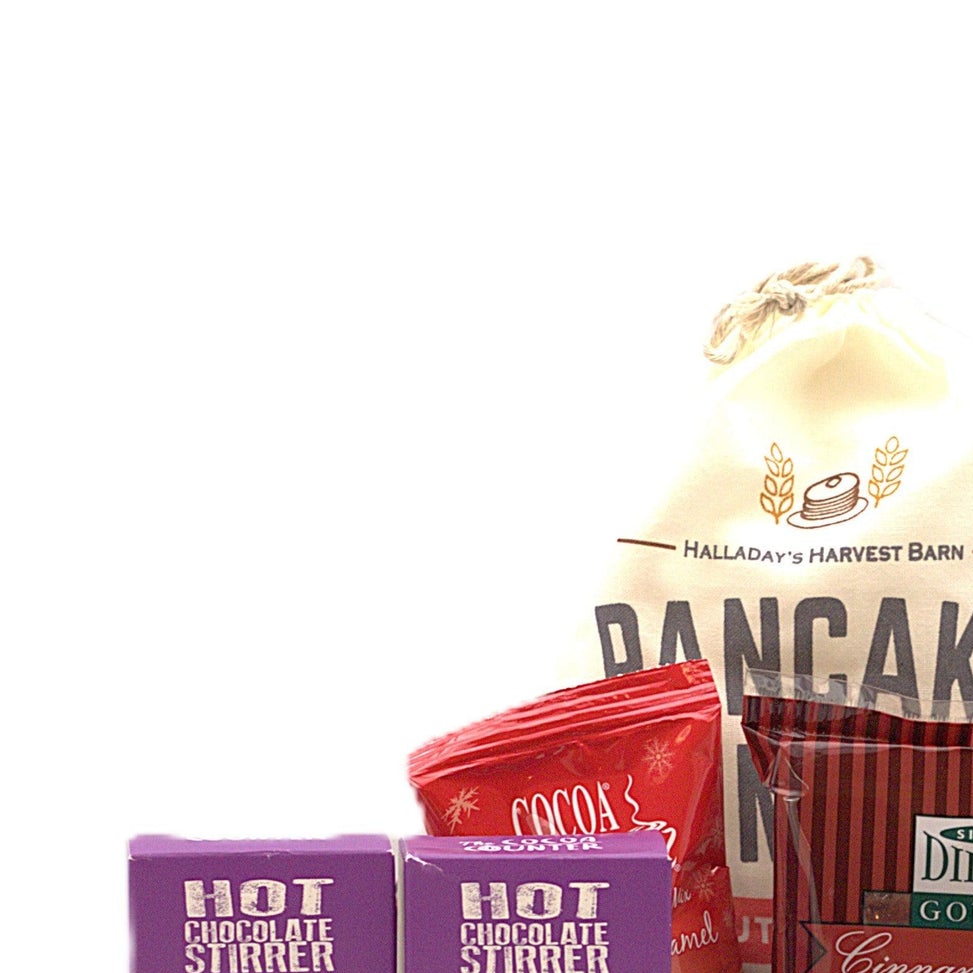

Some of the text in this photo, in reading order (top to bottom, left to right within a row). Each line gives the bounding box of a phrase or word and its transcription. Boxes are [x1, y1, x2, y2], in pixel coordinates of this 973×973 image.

[512, 781, 620, 836] COCOA
[501, 836, 598, 845] COCOA
[183, 878, 335, 918] HOT
[460, 881, 611, 920] HOT
[184, 919, 334, 944] CHOCOLATE
[460, 922, 610, 946] CHOCOLATE
[671, 910, 718, 955] amel
